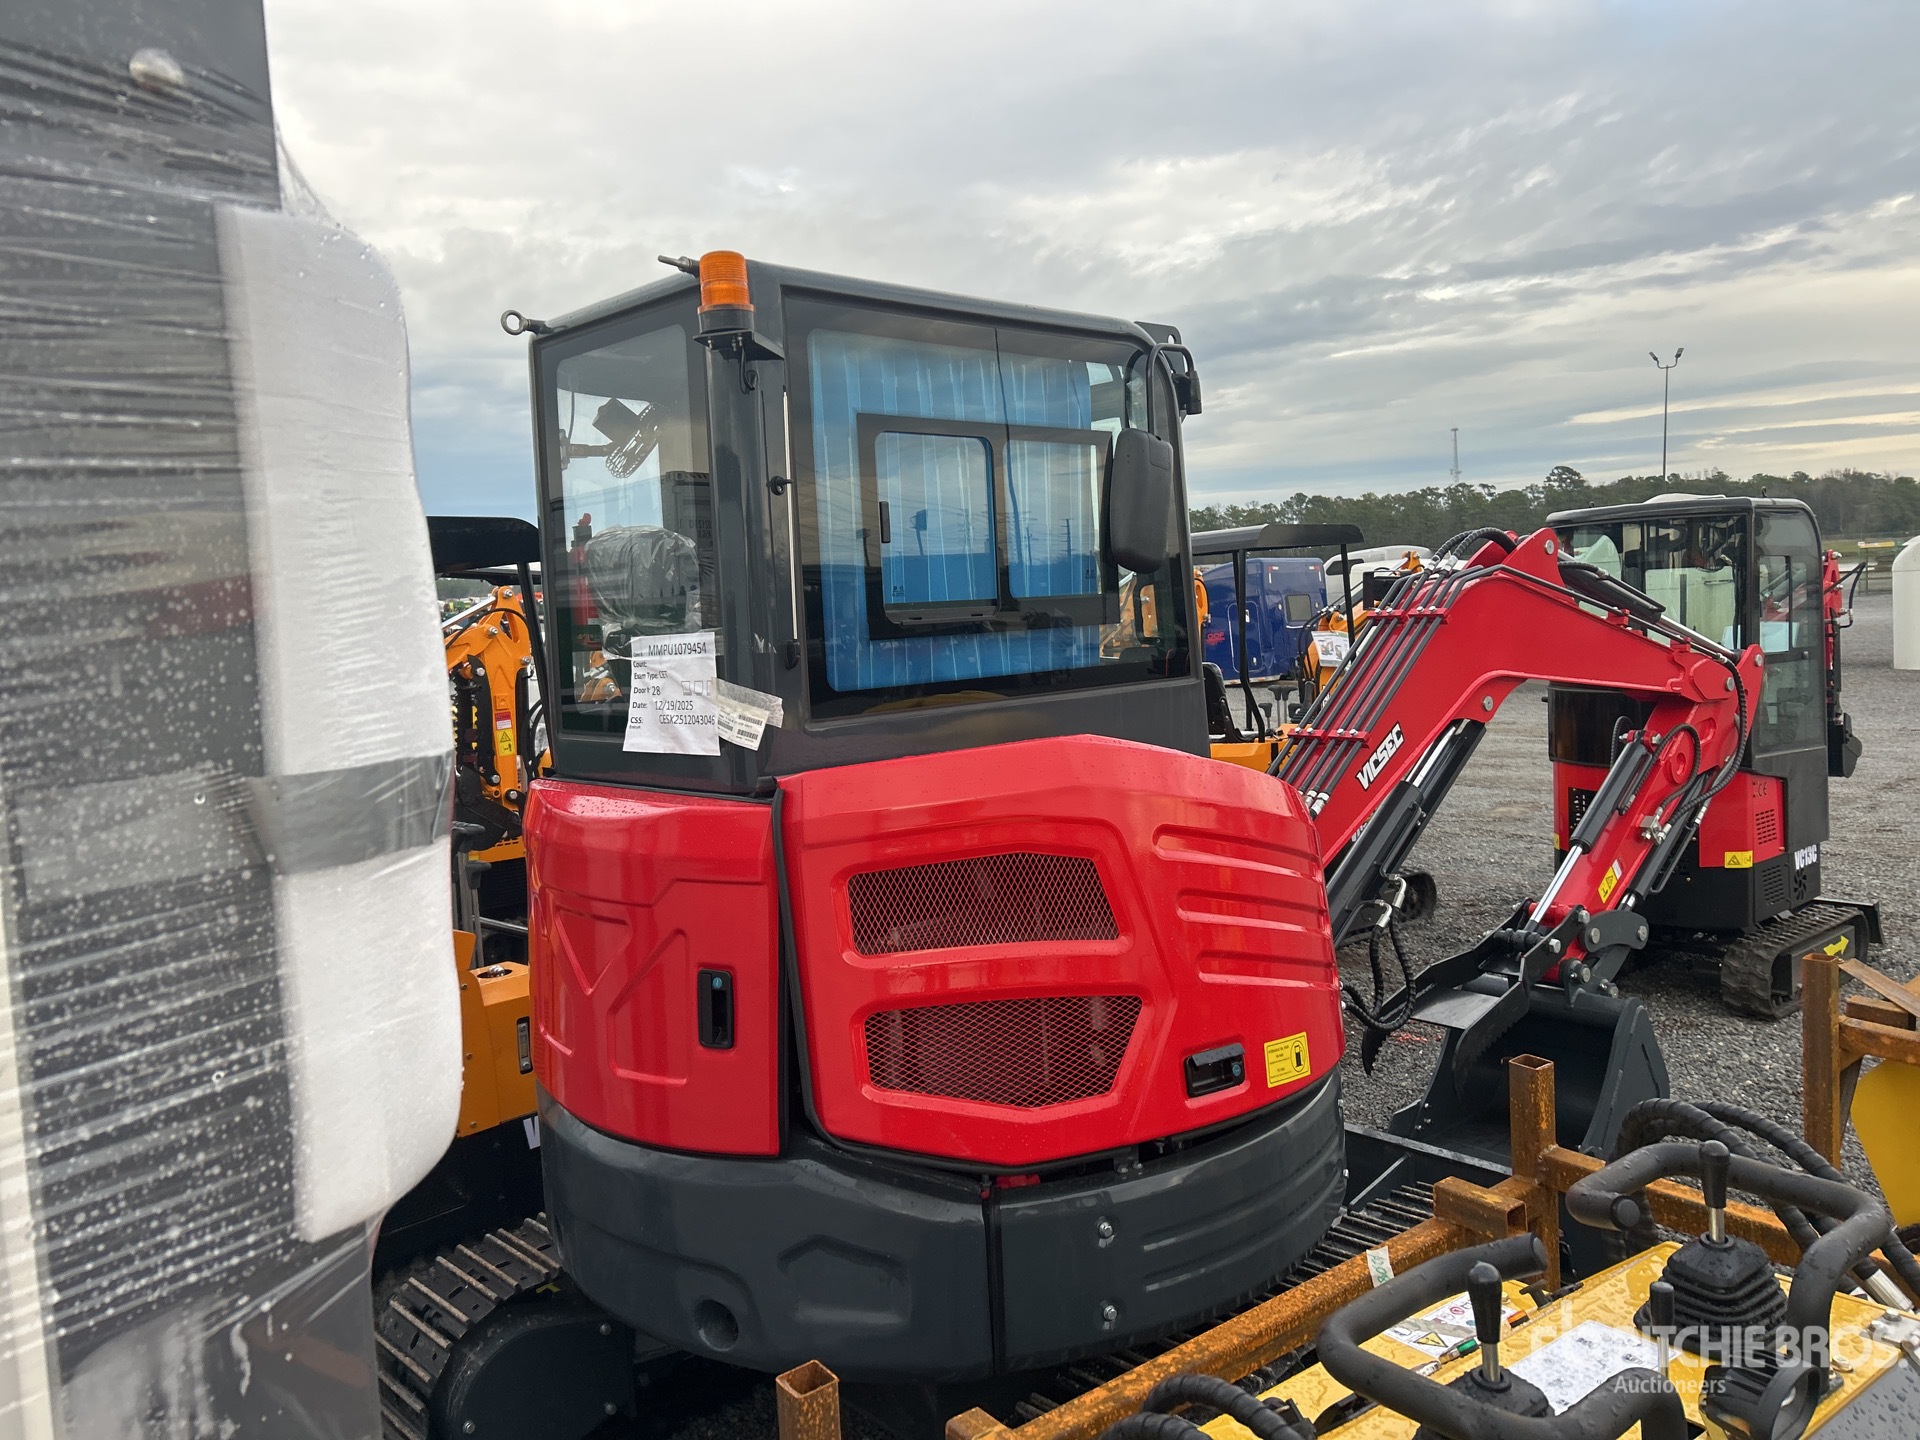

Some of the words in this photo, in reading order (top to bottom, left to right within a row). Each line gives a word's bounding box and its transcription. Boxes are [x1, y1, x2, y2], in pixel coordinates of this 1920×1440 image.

[648, 641, 707, 656] MMPU1079454
[633, 686, 645, 694] Door
[652, 685, 661, 696] 28
[632, 701, 648, 709] Date:
[654, 700, 694, 711] 12/19/2025
[630, 716, 643, 724] CSS:
[1356, 722, 1405, 791] VICSEC
